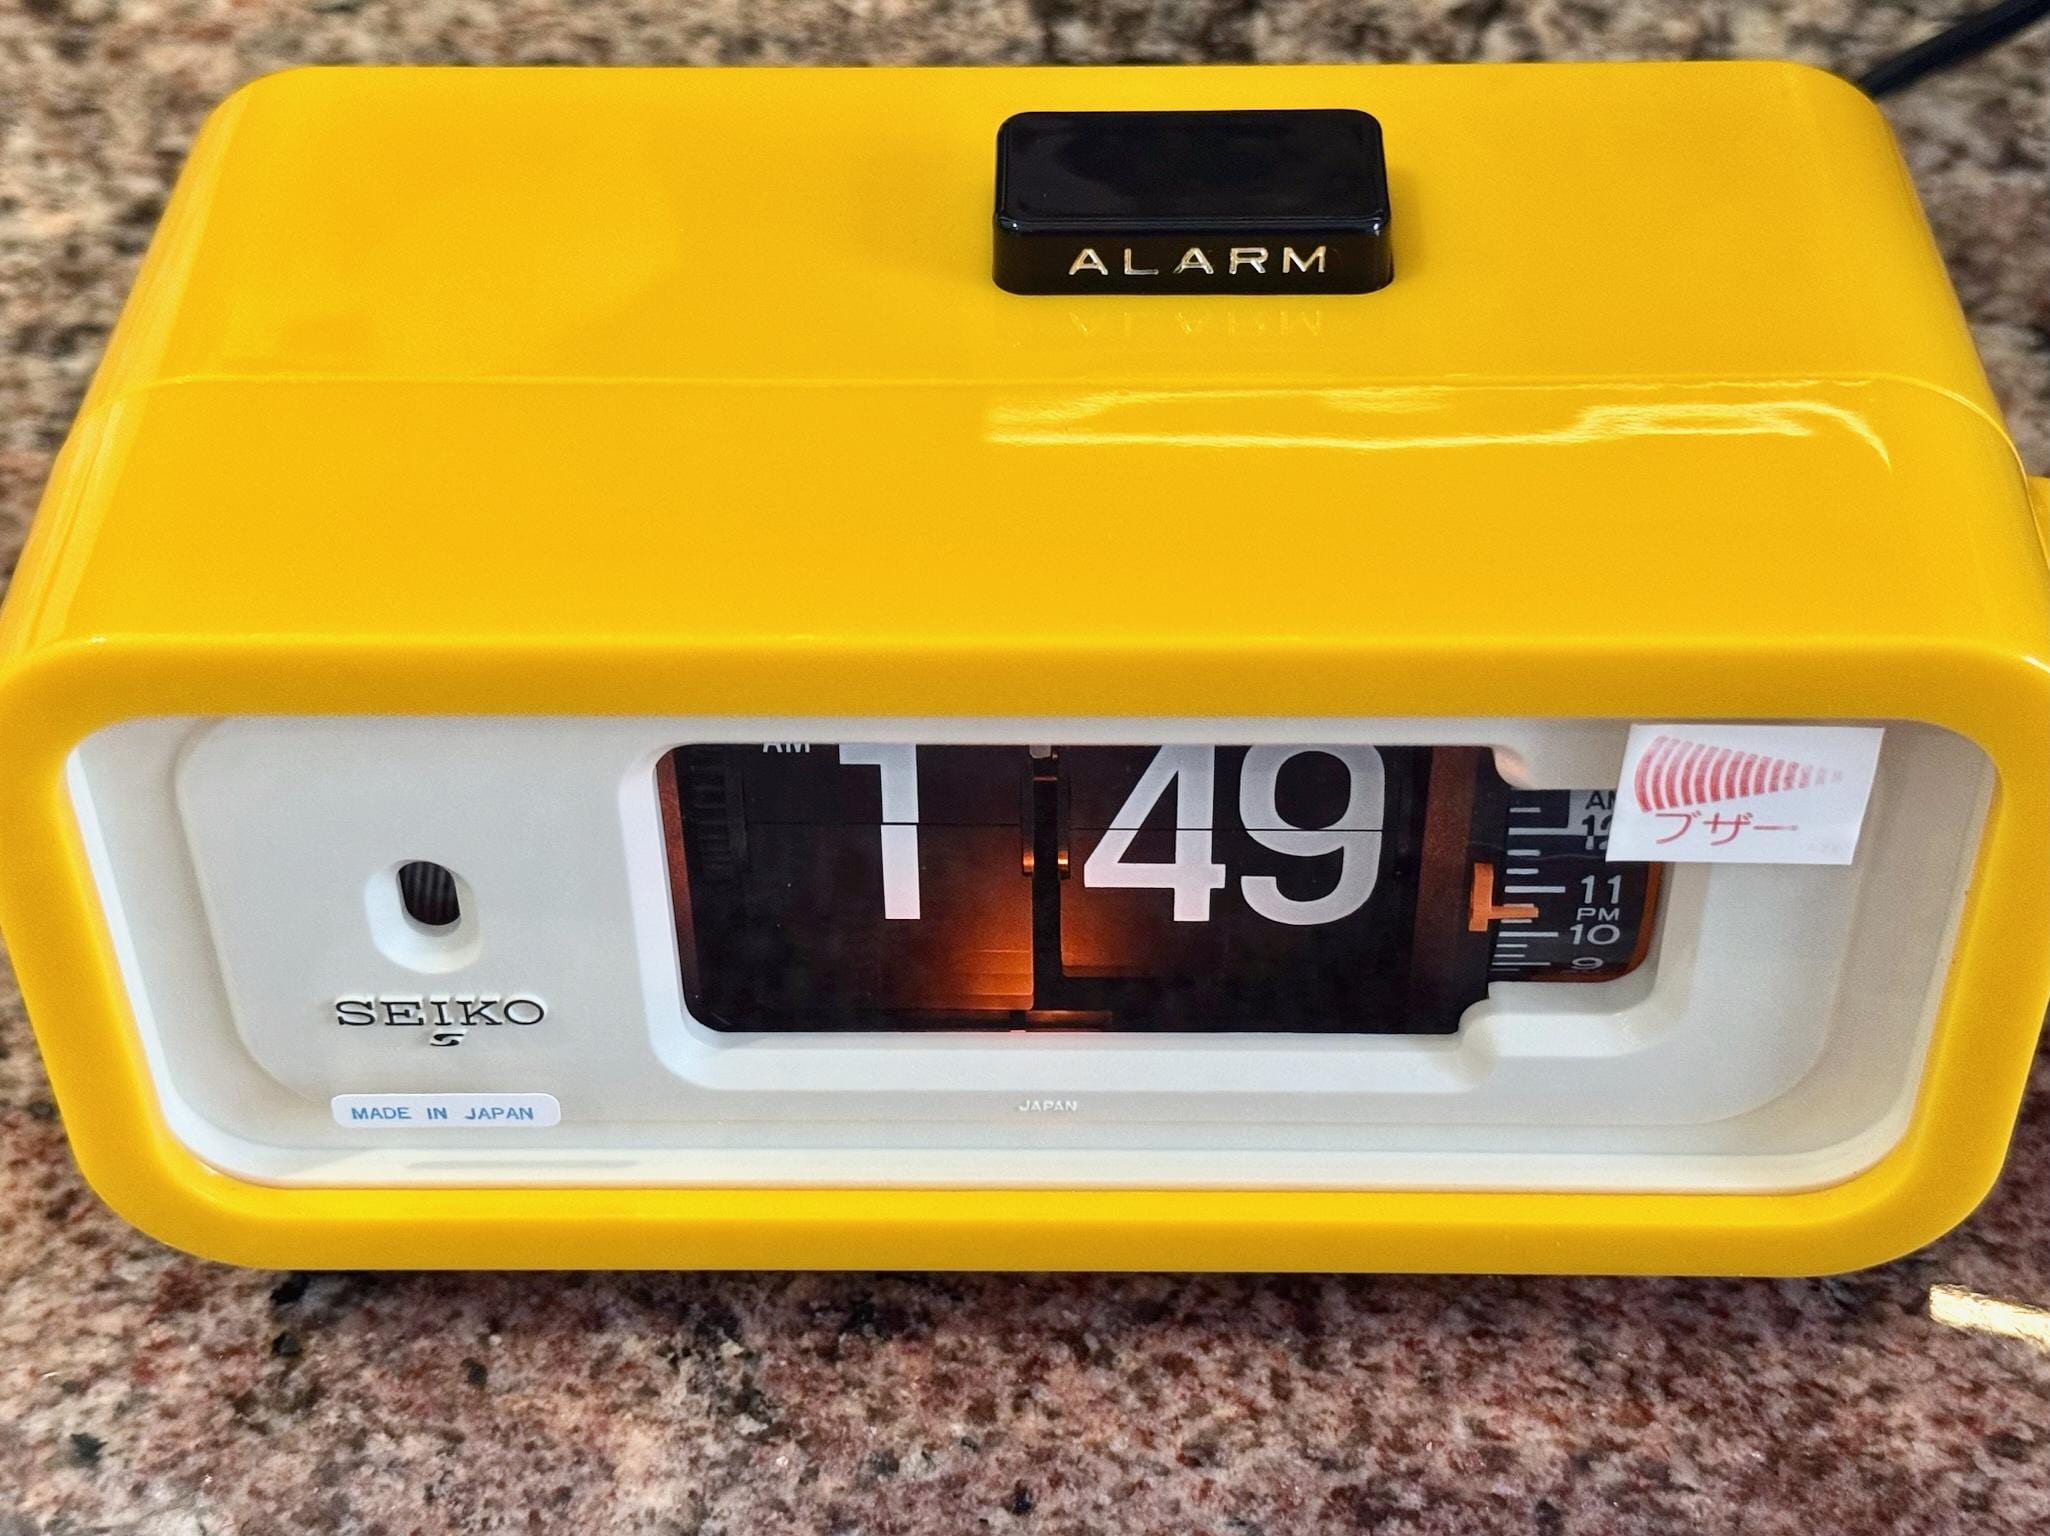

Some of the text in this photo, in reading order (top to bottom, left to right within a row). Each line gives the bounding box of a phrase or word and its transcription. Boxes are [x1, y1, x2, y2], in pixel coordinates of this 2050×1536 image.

[1068, 246, 1327, 275] ALARM
[839, 743, 1385, 925] 1 49
[1655, 811, 1798, 845] ブザー
[1581, 875, 1621, 904] 11
[1576, 907, 1620, 921] PM
[1569, 923, 1620, 945] 10
[335, 999, 545, 1026] SEIKO
[351, 1106, 534, 1120] MADE IN JAPAN
[1019, 1099, 1077, 1112] JAPAN
